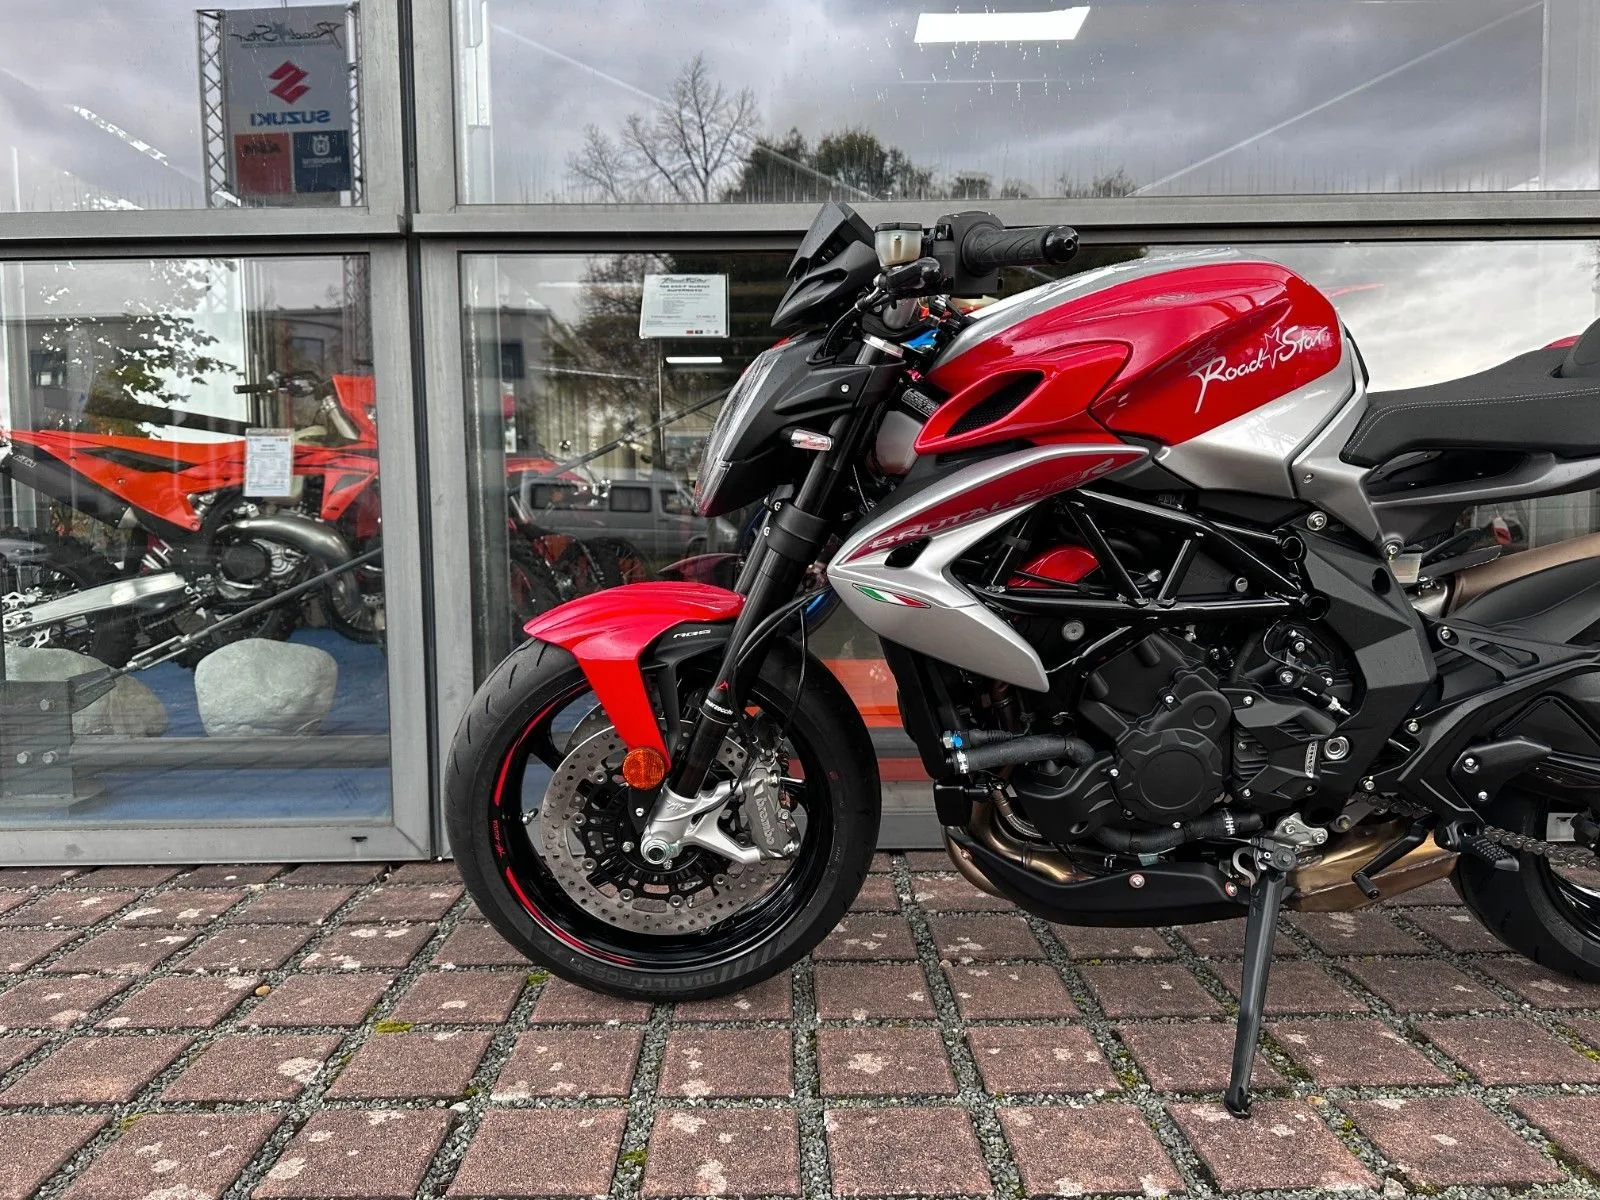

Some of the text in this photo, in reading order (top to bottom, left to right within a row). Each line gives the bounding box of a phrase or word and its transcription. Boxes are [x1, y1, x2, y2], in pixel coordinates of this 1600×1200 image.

[1188, 325, 1329, 414] Road Star
[868, 488, 1041, 549] BRUTALE
[756, 797, 776, 846] brembo
[638, 971, 716, 988] DIABLO
